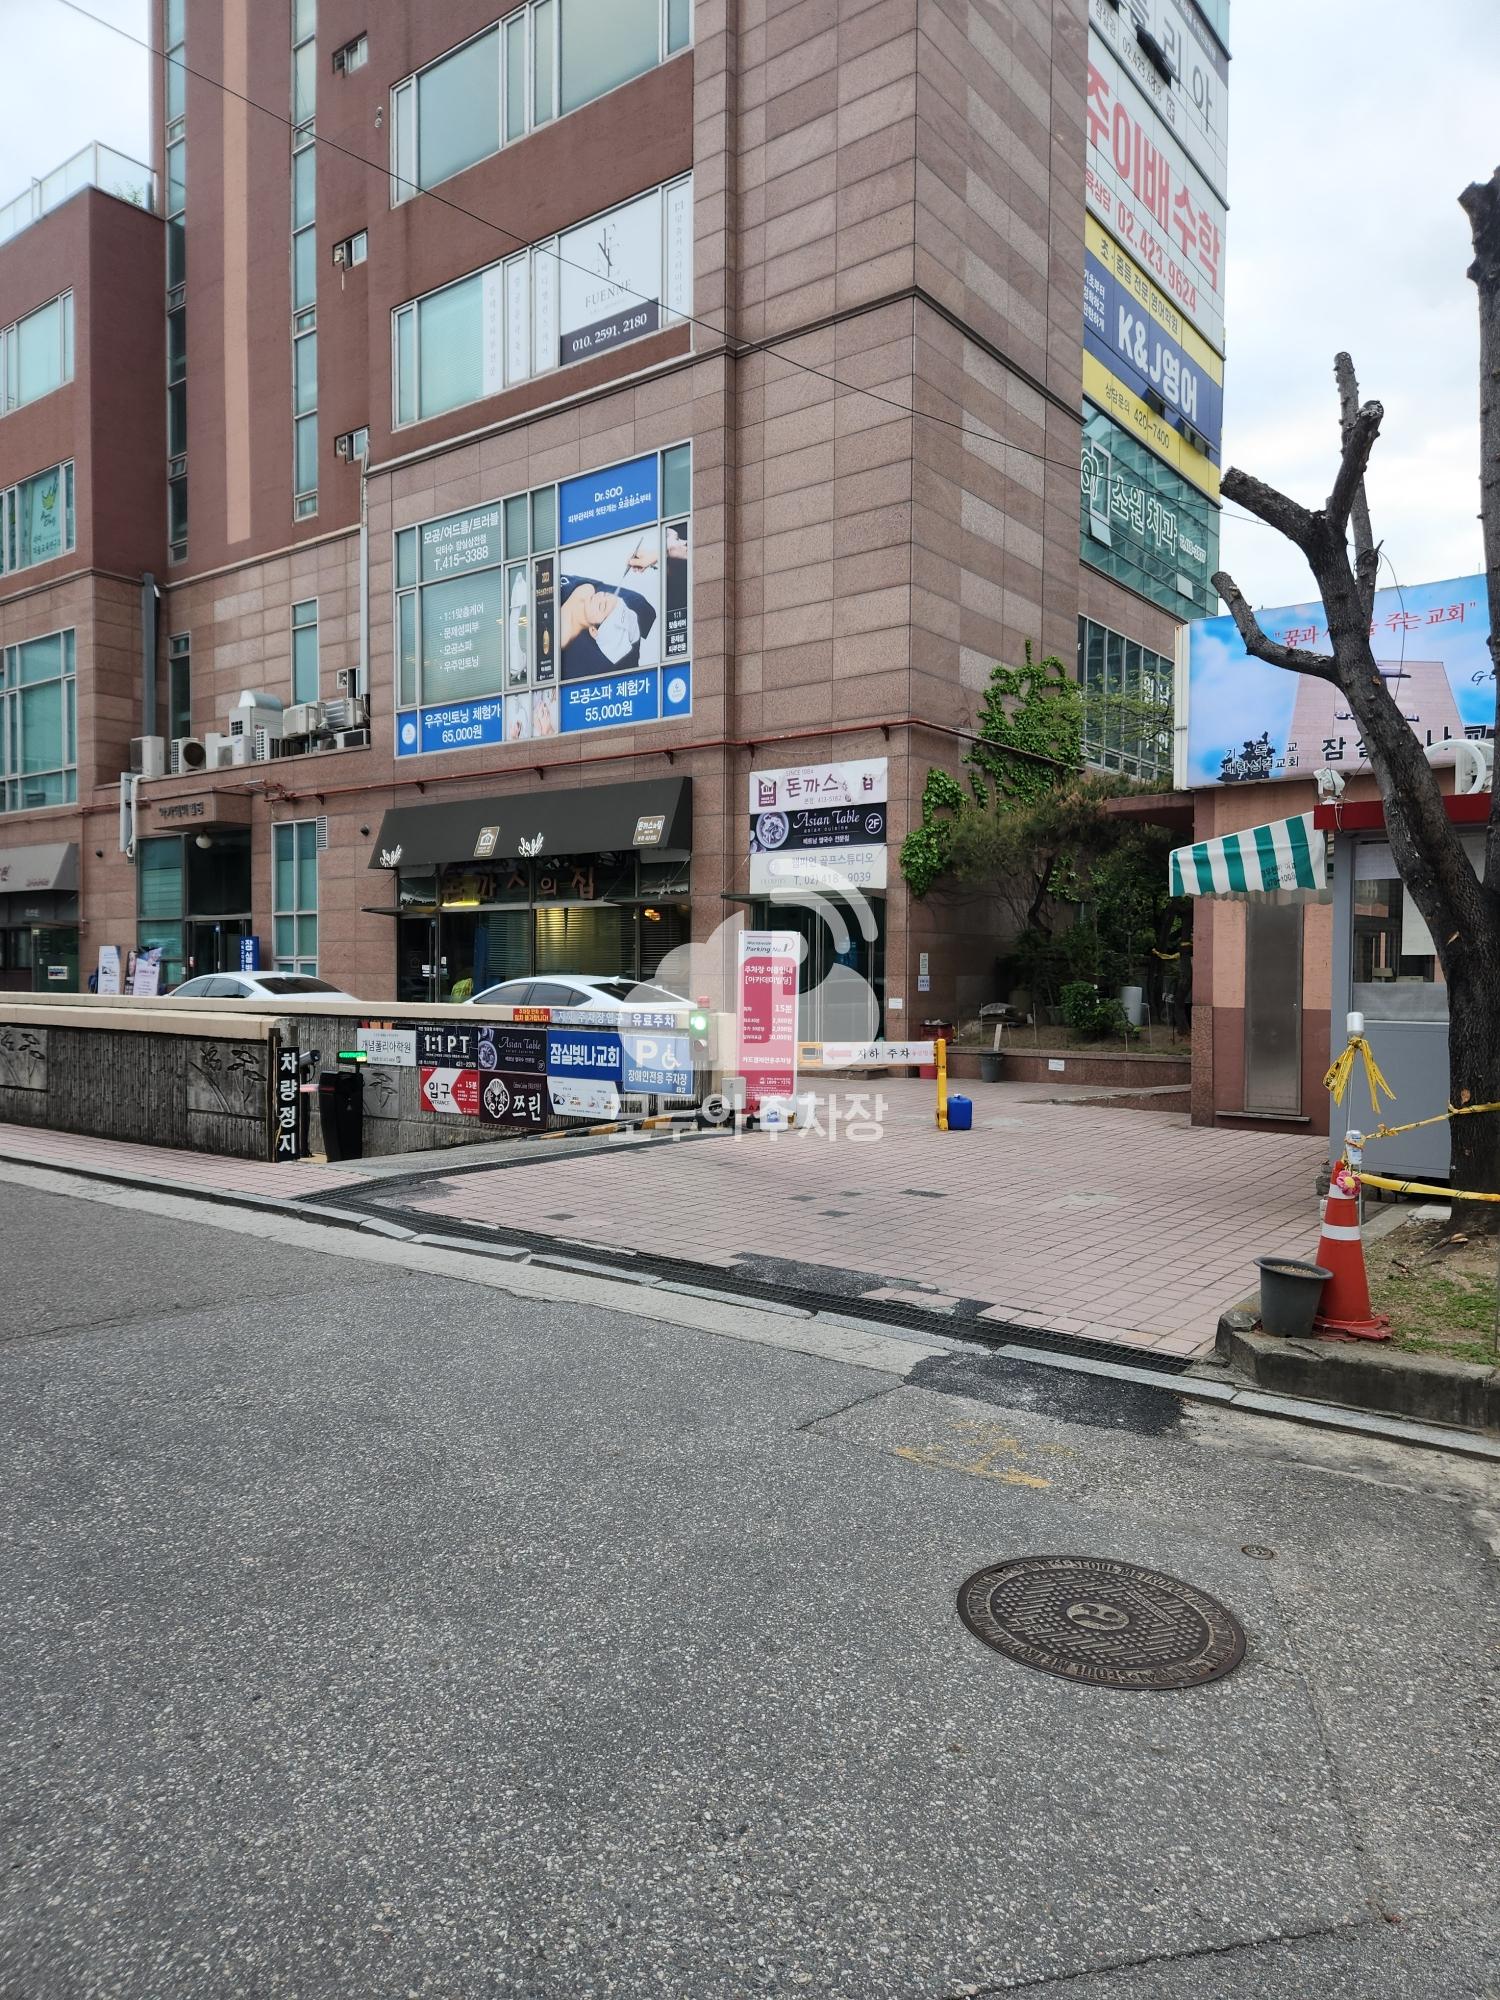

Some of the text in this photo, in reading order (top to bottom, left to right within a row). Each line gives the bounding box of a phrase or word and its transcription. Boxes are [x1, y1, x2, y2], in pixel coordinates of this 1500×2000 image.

[1118, 201, 1197, 313] 02.423.9624
[623, 312, 648, 332] 2180
[1118, 304, 1198, 423] K&J영어
[1134, 408, 1170, 449] 420-7400
[1385, 611, 1422, 634] 주는
[443, 640, 472, 655] 모공스파
[444, 655, 479, 672] 우주인토닝
[569, 676, 650, 704] 모공스파 체험가
[424, 702, 502, 727] 우주인토닝 체험가
[585, 700, 633, 722] 55,000원
[441, 723, 483, 744] 65,000원
[793, 808, 880, 829] Asian Table 2F
[820, 852, 874, 867] 골프스튜디오
[848, 871, 871, 883] 9039
[744, 965, 765, 974] 주차장
[632, 1013, 675, 1028] 유료주차
[424, 1034, 442, 1053] 1:1
[498, 1036, 541, 1050] Asian Table
[636, 1039, 658, 1068] P
[550, 1043, 620, 1068] 잠실빛나교회
[887, 1048, 910, 1060] 주차
[628, 1069, 687, 1086] 장애인전용 주차장
[428, 1081, 450, 1099] 입구
[280, 1052, 298, 1155] 차량정지
[512, 1092, 541, 1121] 쯔린
